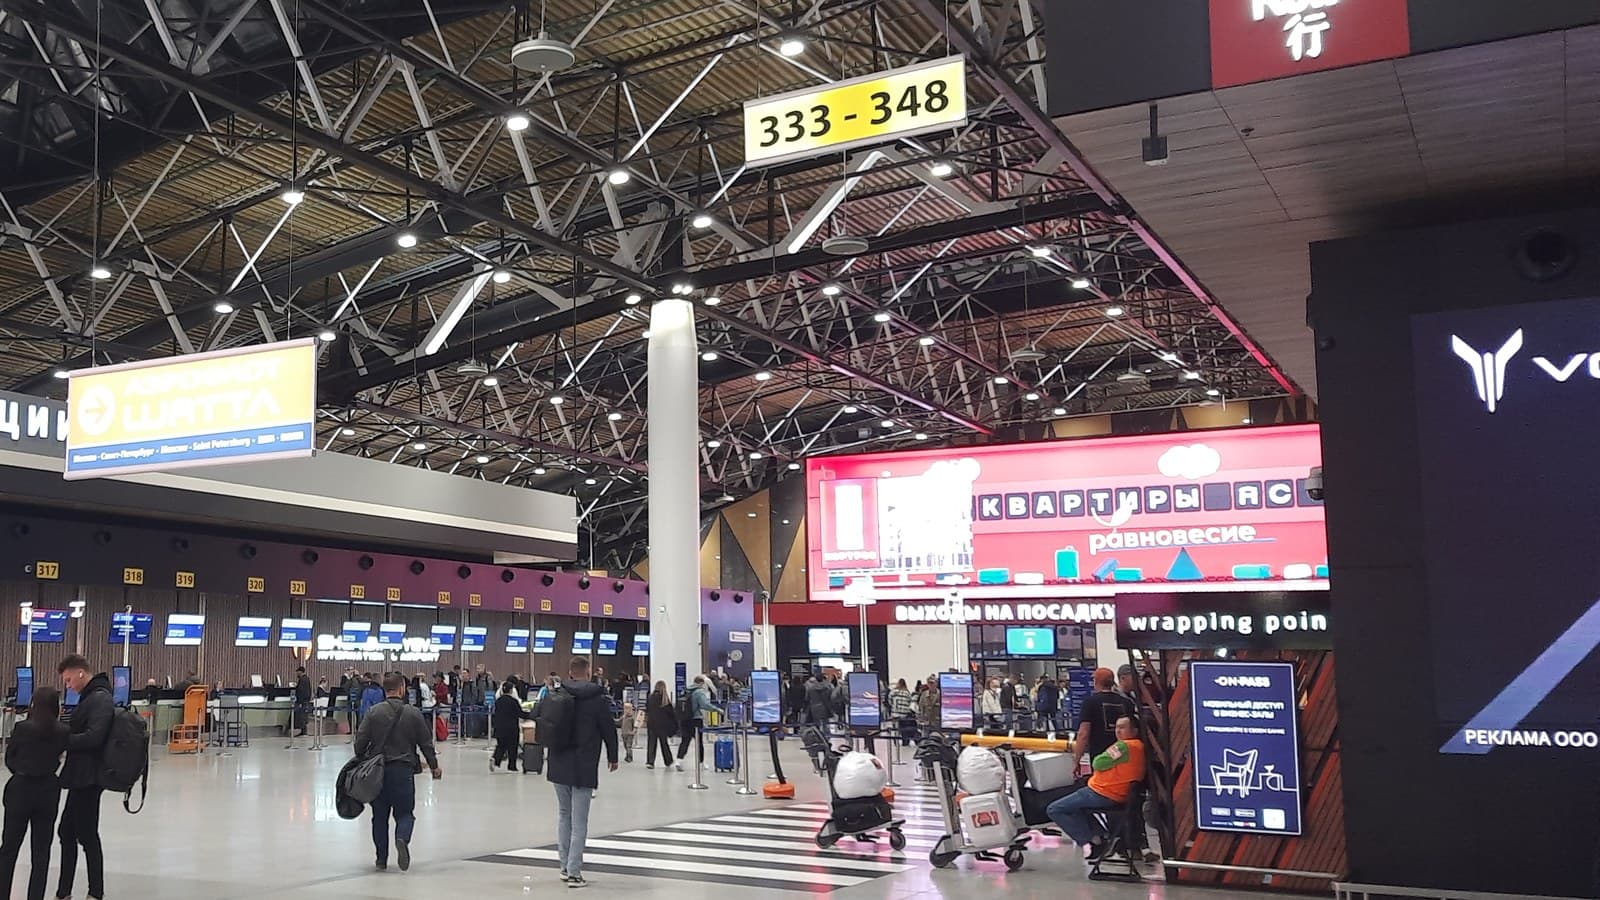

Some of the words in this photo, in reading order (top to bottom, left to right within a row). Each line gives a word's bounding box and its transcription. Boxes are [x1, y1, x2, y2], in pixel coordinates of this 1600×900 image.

[1283, 11, 1330, 61] 行
[759, 105, 831, 147] 333
[870, 79, 949, 125] 348
[982, 487, 1199, 517] КВАРТИРЫ
[1089, 525, 1257, 555] равновесие
[38, 564, 57, 576] 317
[125, 570, 142, 582] 318
[177, 573, 193, 585] 319
[249, 579, 263, 590] 320
[291, 582, 305, 593] 321
[351, 586, 364, 597] 322
[388, 589, 399, 599] 323
[895, 605, 981, 623] ВЫХОДЫ
[984, 604, 1014, 620] НА
[1017, 603, 1115, 623] ПОСАДКУ
[1128, 611, 1253, 635] wrapping
[1265, 611, 1327, 635] poin
[1465, 729, 1551, 747] РЕКЛАМА
[1554, 731, 1598, 748] ООО
